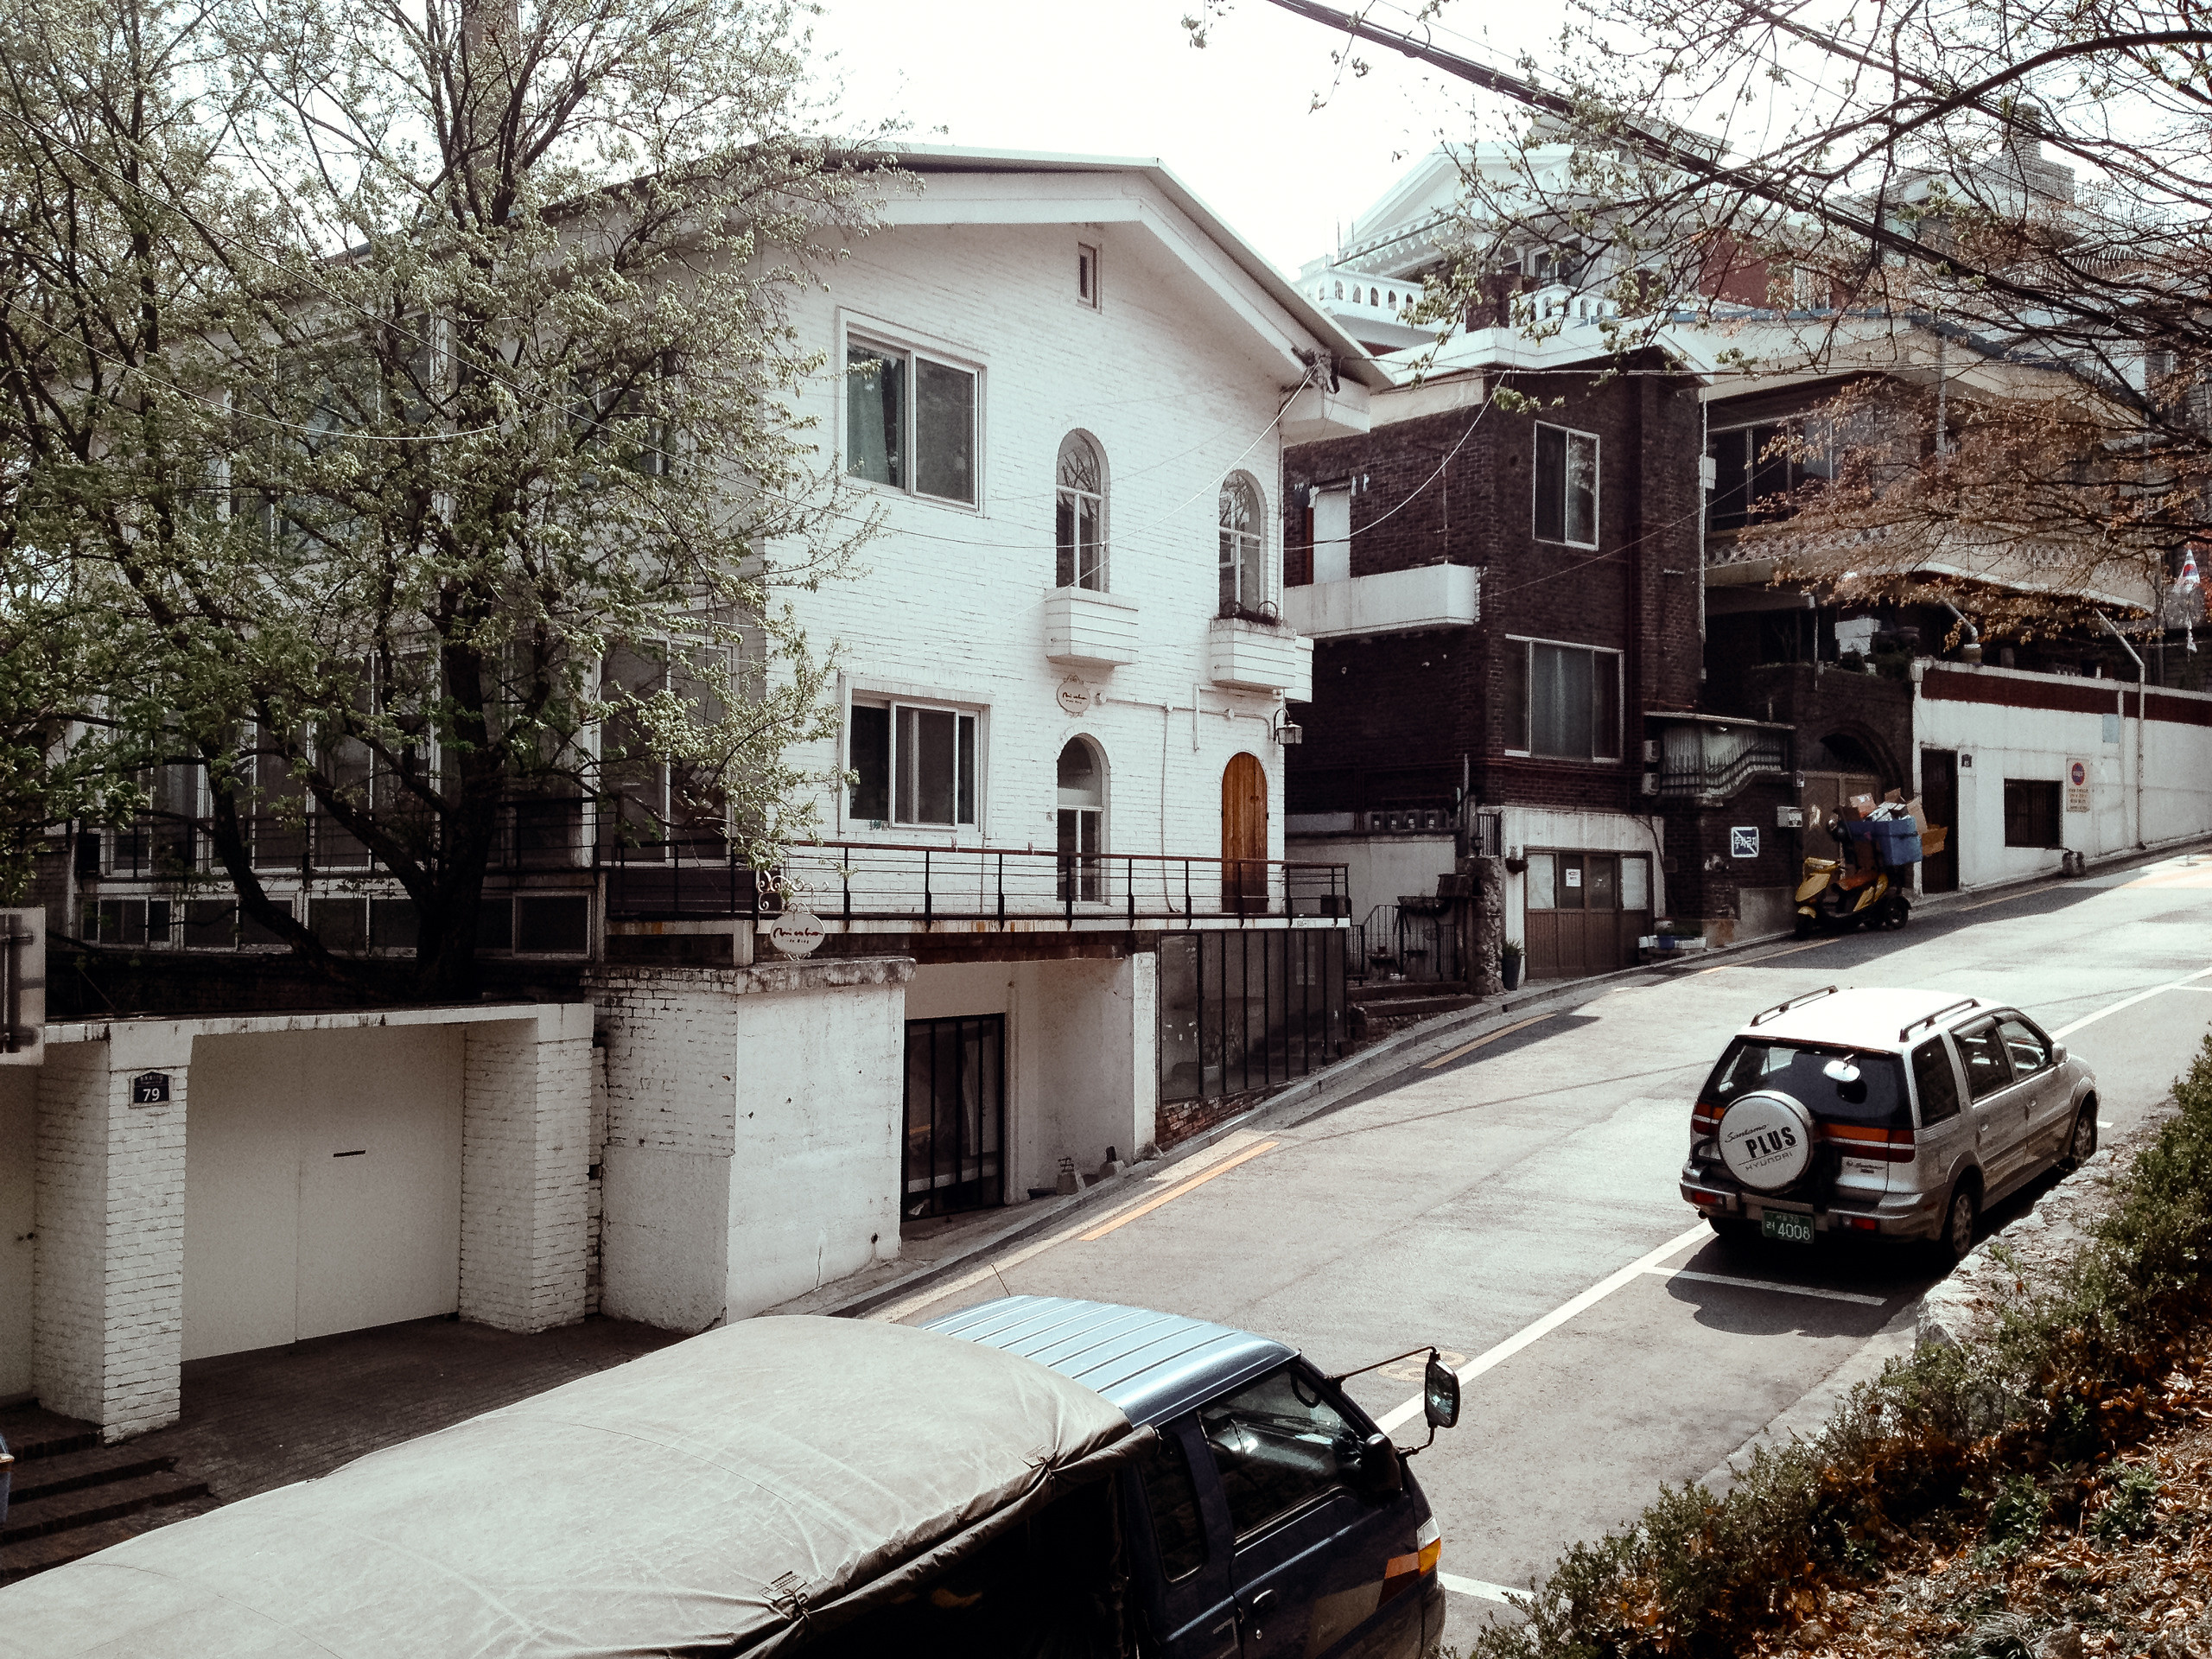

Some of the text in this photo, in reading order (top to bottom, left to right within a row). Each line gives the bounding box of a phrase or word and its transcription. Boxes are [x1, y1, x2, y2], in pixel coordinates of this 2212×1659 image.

[143, 1087, 161, 1102] 79
[1725, 1124, 1768, 1143] Santamo
[1745, 1126, 1796, 1159] PLUS
[1745, 1151, 1793, 1172] HYUNDAI
[1777, 1223, 1811, 1241] 4008
